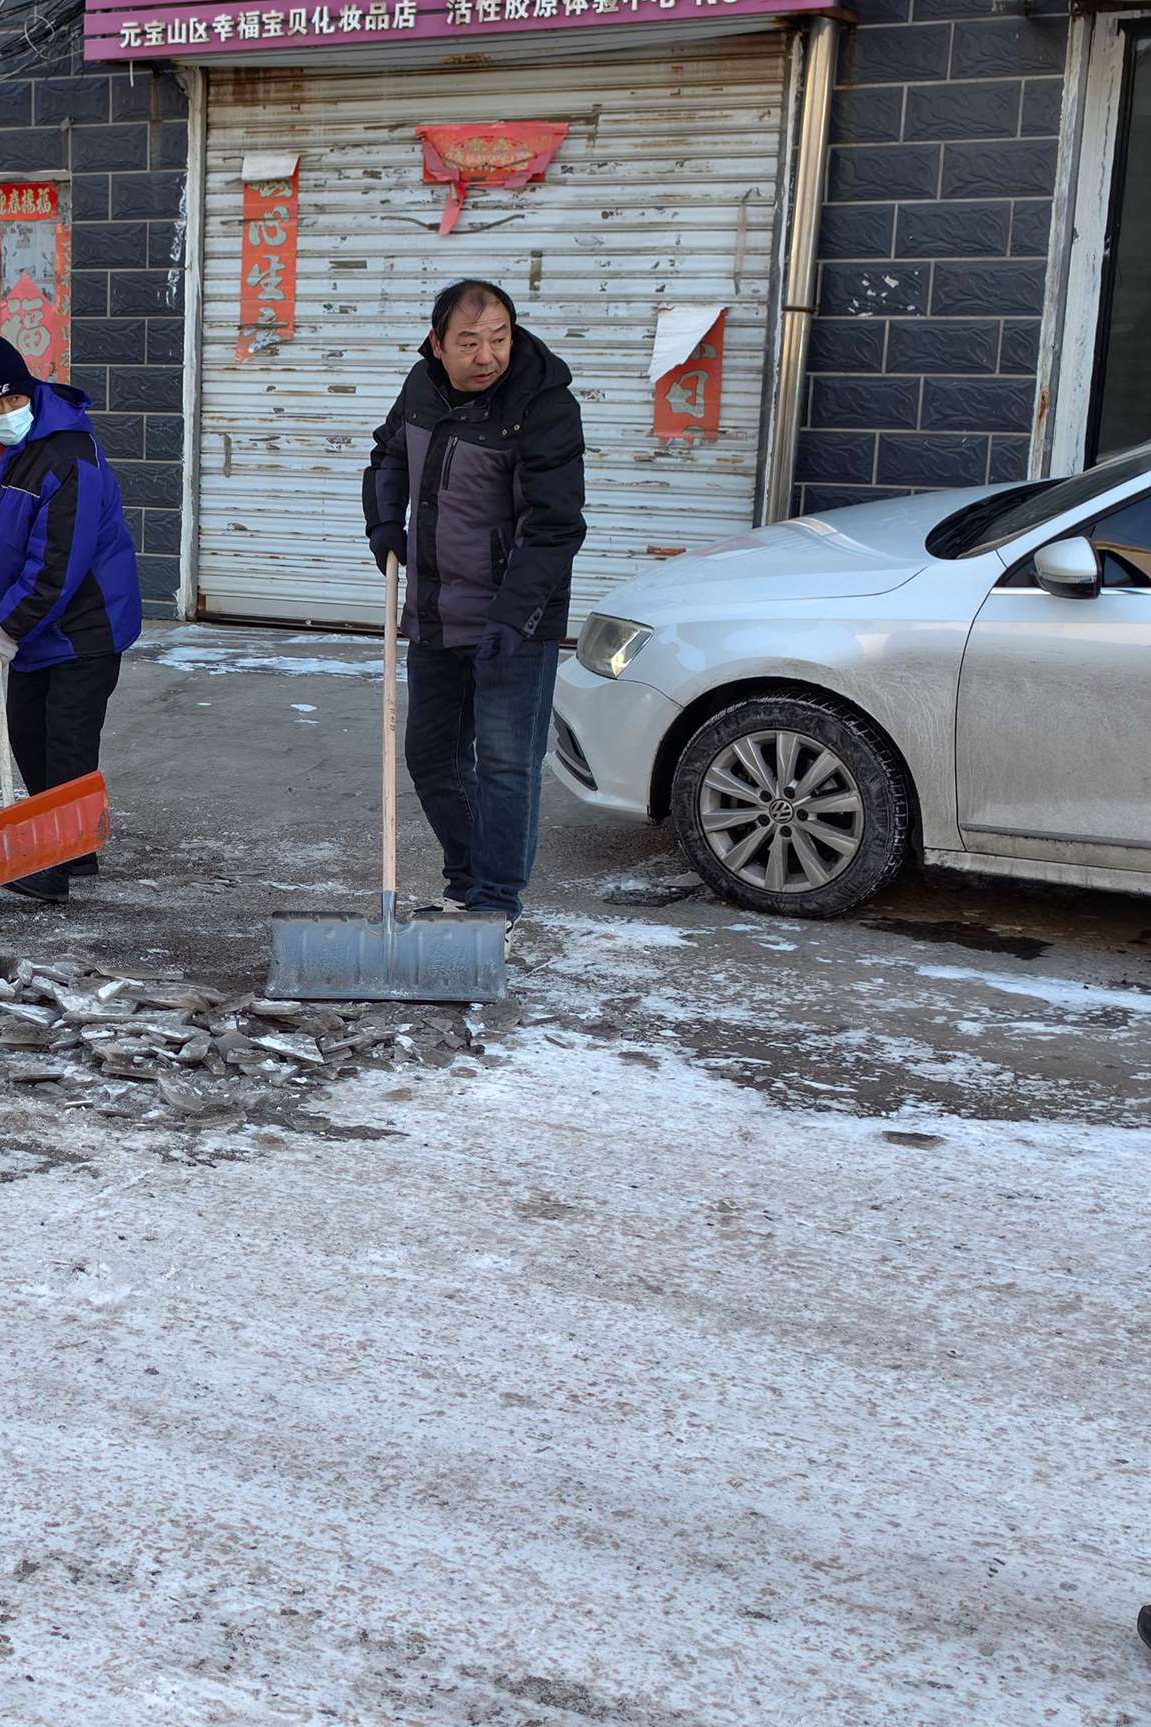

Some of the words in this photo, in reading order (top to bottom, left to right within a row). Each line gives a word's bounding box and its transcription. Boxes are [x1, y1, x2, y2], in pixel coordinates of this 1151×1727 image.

[120, 1, 417, 48] 元宝山区幸福宝贝化妆品店
[1, 298, 51, 357] 福
